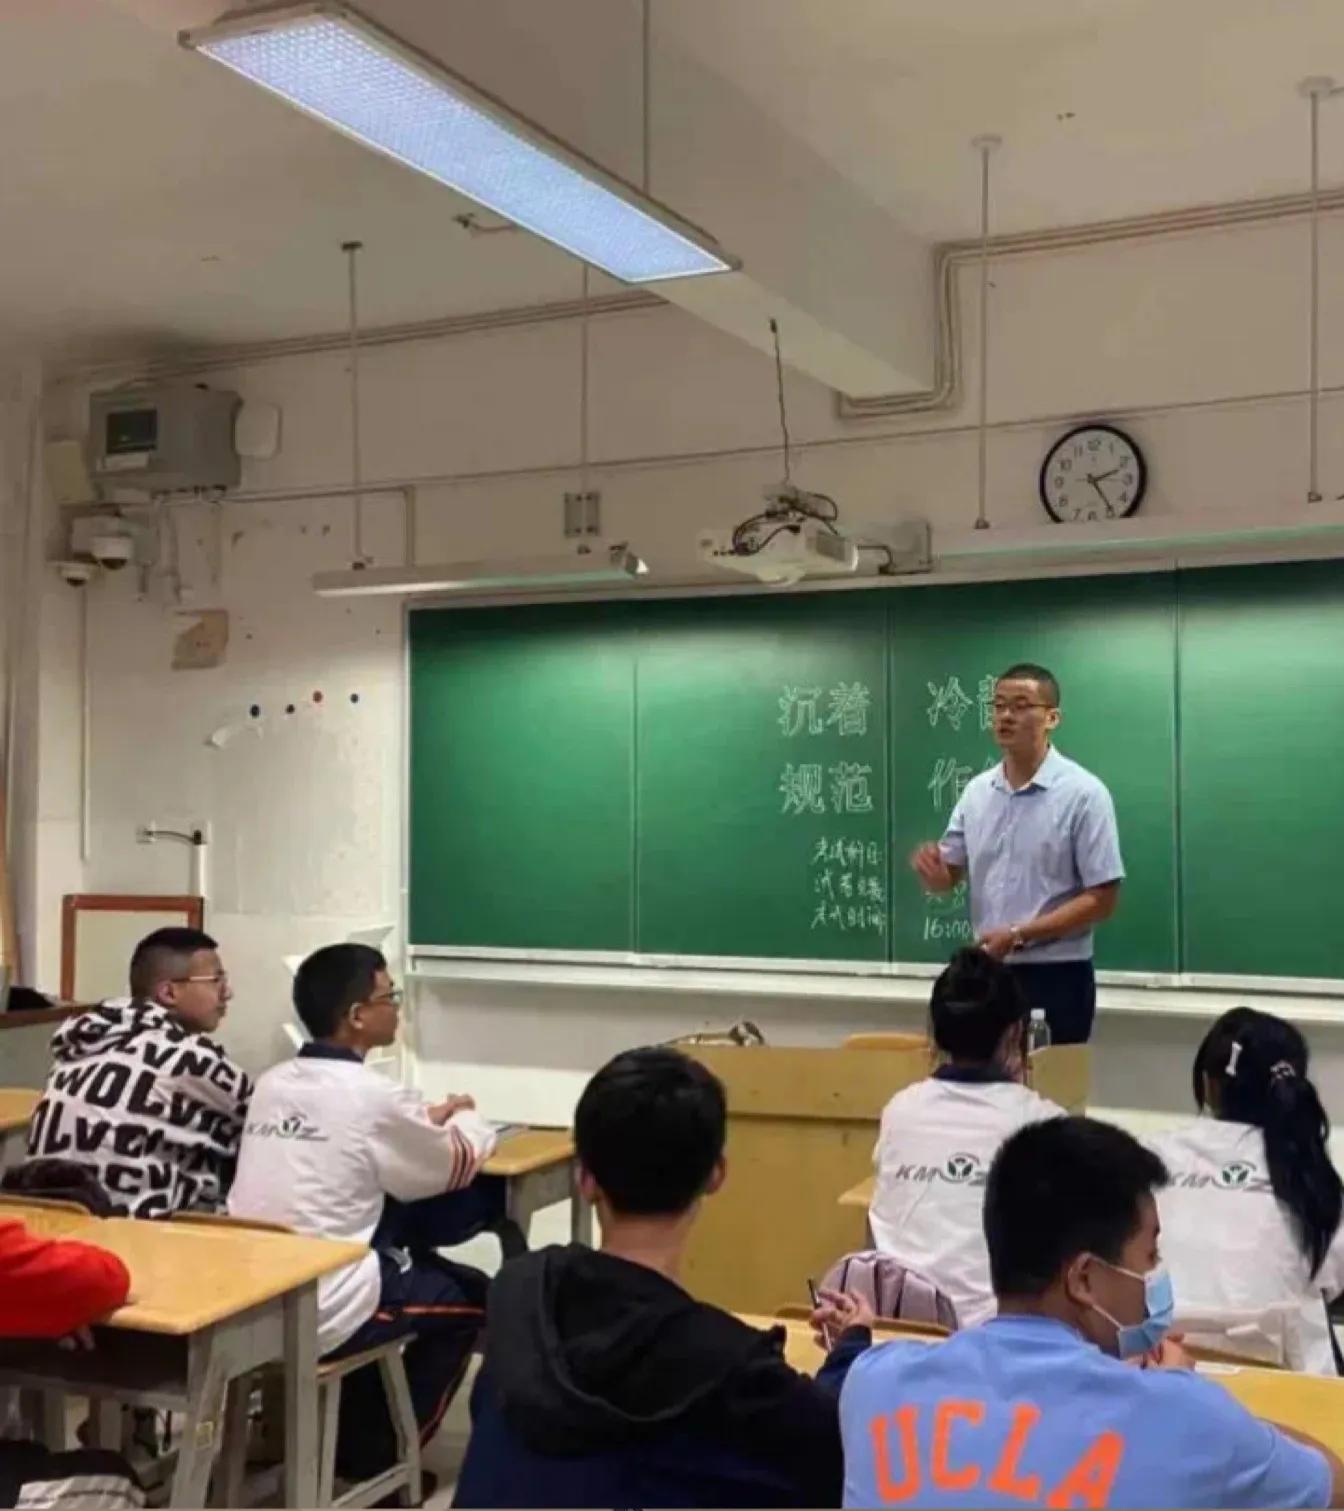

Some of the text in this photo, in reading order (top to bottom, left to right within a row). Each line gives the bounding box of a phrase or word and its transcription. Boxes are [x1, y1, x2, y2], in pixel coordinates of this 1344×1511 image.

[778, 681, 871, 737] 沉着
[779, 761, 873, 815] 规范
[868, 1396, 1125, 1509] UCLA
